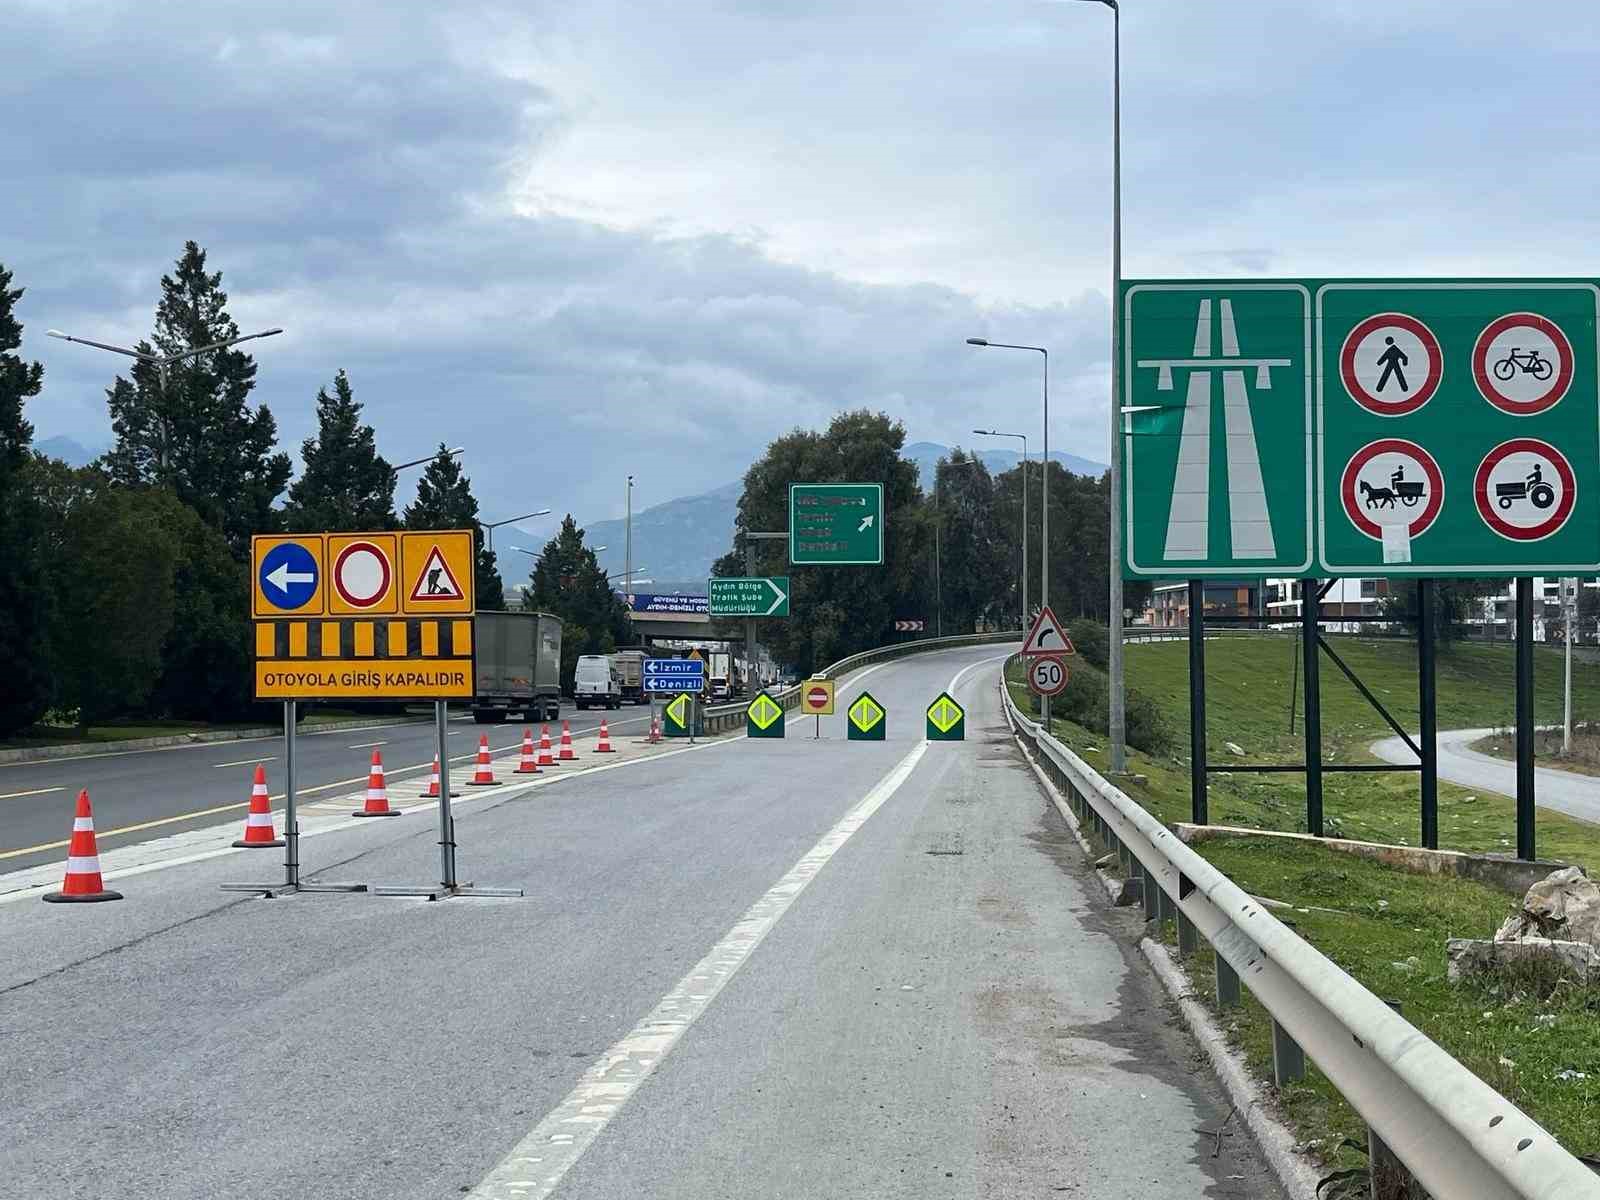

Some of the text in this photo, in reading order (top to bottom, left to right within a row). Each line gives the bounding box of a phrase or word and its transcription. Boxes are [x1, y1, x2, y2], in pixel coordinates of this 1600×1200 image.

[712, 583, 762, 592] Aydın Bölge
[741, 594, 763, 602] Şube
[264, 669, 465, 689] OTOYOLA GİRİŞ KAPALIDIR
[1037, 665, 1061, 685] 50
[659, 679, 701, 689] Denizli
